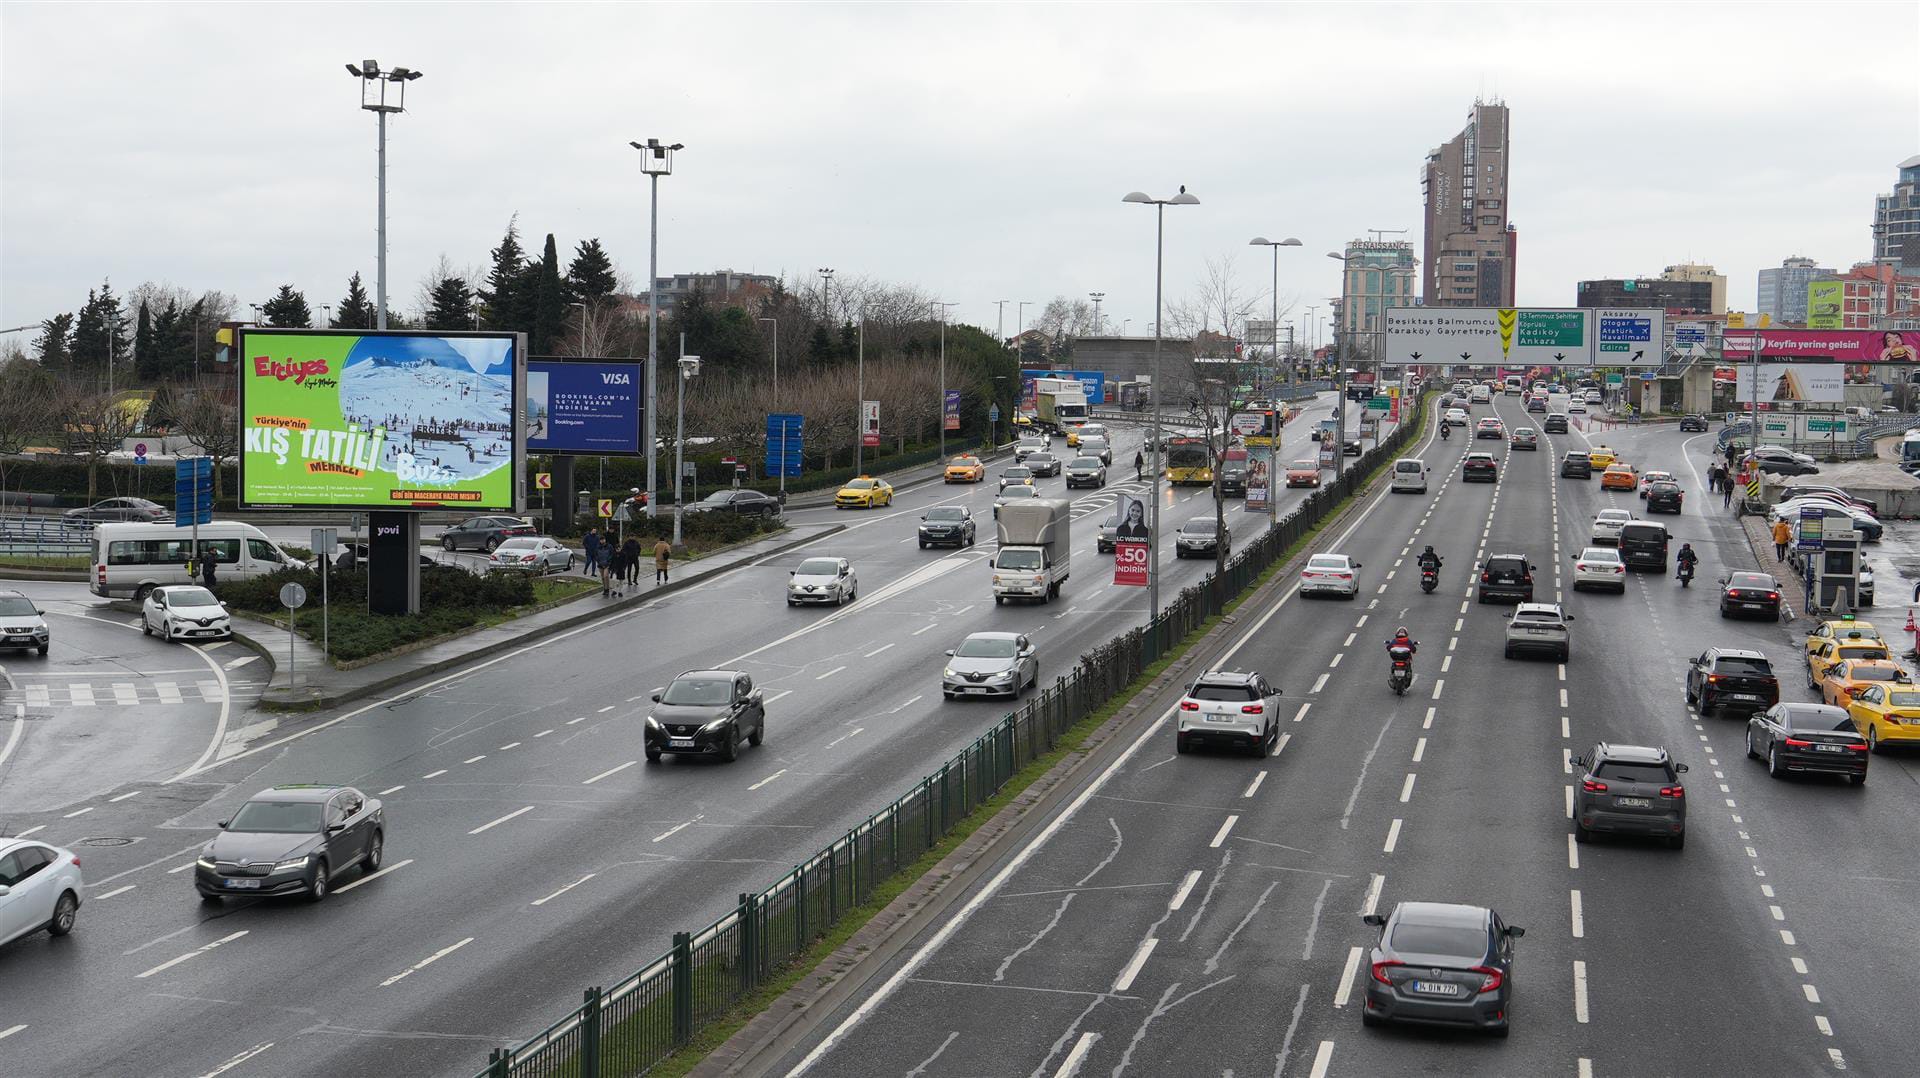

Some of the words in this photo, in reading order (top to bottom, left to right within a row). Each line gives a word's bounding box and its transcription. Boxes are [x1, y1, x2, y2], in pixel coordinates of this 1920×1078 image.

[1388, 328, 1431, 336] Karaköy
[1437, 328, 1498, 336] Gayrettepe
[1520, 329, 1560, 337] Kadıköy
[1768, 340, 1796, 350] Keyfin
[1798, 340, 1827, 350] yerine
[1829, 340, 1860, 350] gelsin!
[253, 356, 329, 385] Erciyes
[600, 373, 630, 385] VISA
[256, 417, 307, 429] Türkiye'nin
[245, 427, 290, 465] KIŞ
[300, 425, 384, 472] TATİLİ
[377, 525, 400, 536] yovi
[1116, 548, 1147, 563] %50
[1115, 564, 1147, 573] İNDİRİM
